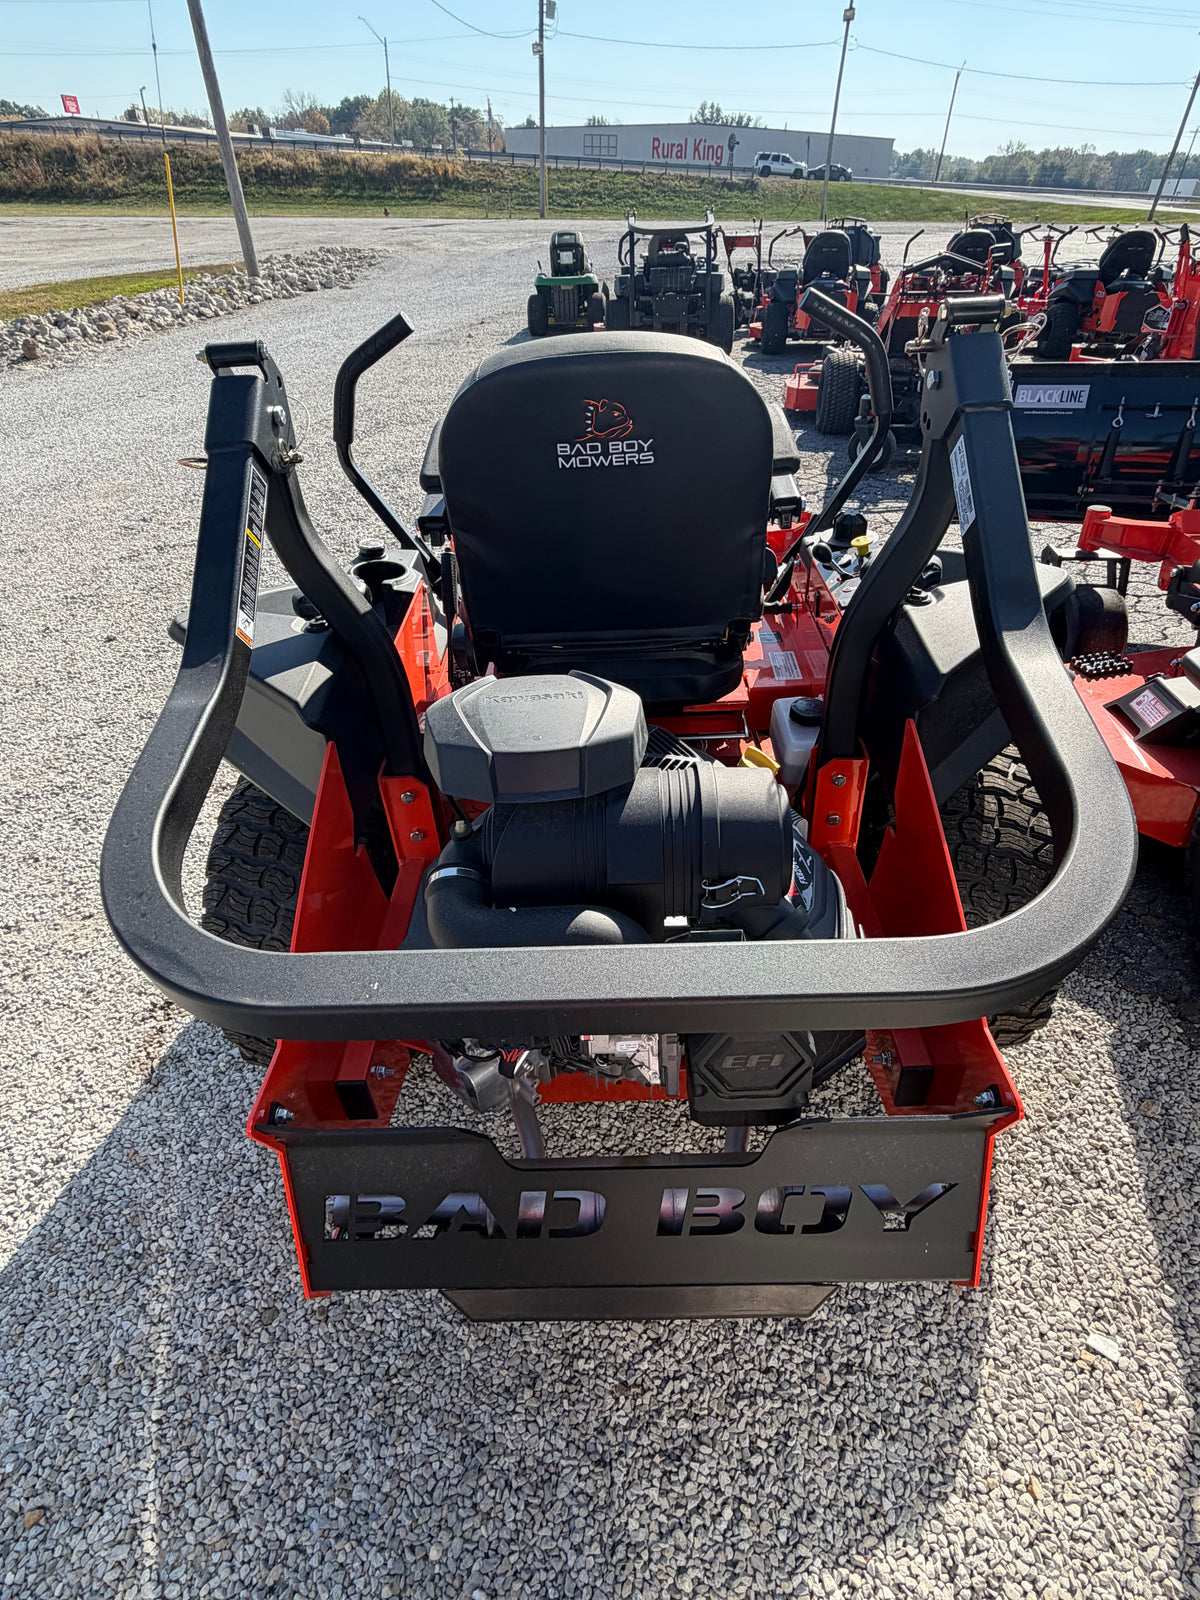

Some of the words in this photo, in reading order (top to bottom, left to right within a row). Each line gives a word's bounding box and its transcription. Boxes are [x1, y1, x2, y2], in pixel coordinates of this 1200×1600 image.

[651, 137, 688, 160] Rural
[692, 138, 724, 166] King
[1018, 389, 1086, 403] BLACKLINE
[556, 442, 602, 455] BAD
[608, 439, 654, 453] BOY
[557, 451, 655, 469] MOWERS
[721, 1053, 785, 1069] EFI
[323, 1190, 607, 1242] BAD
[656, 1182, 960, 1237] BOY
